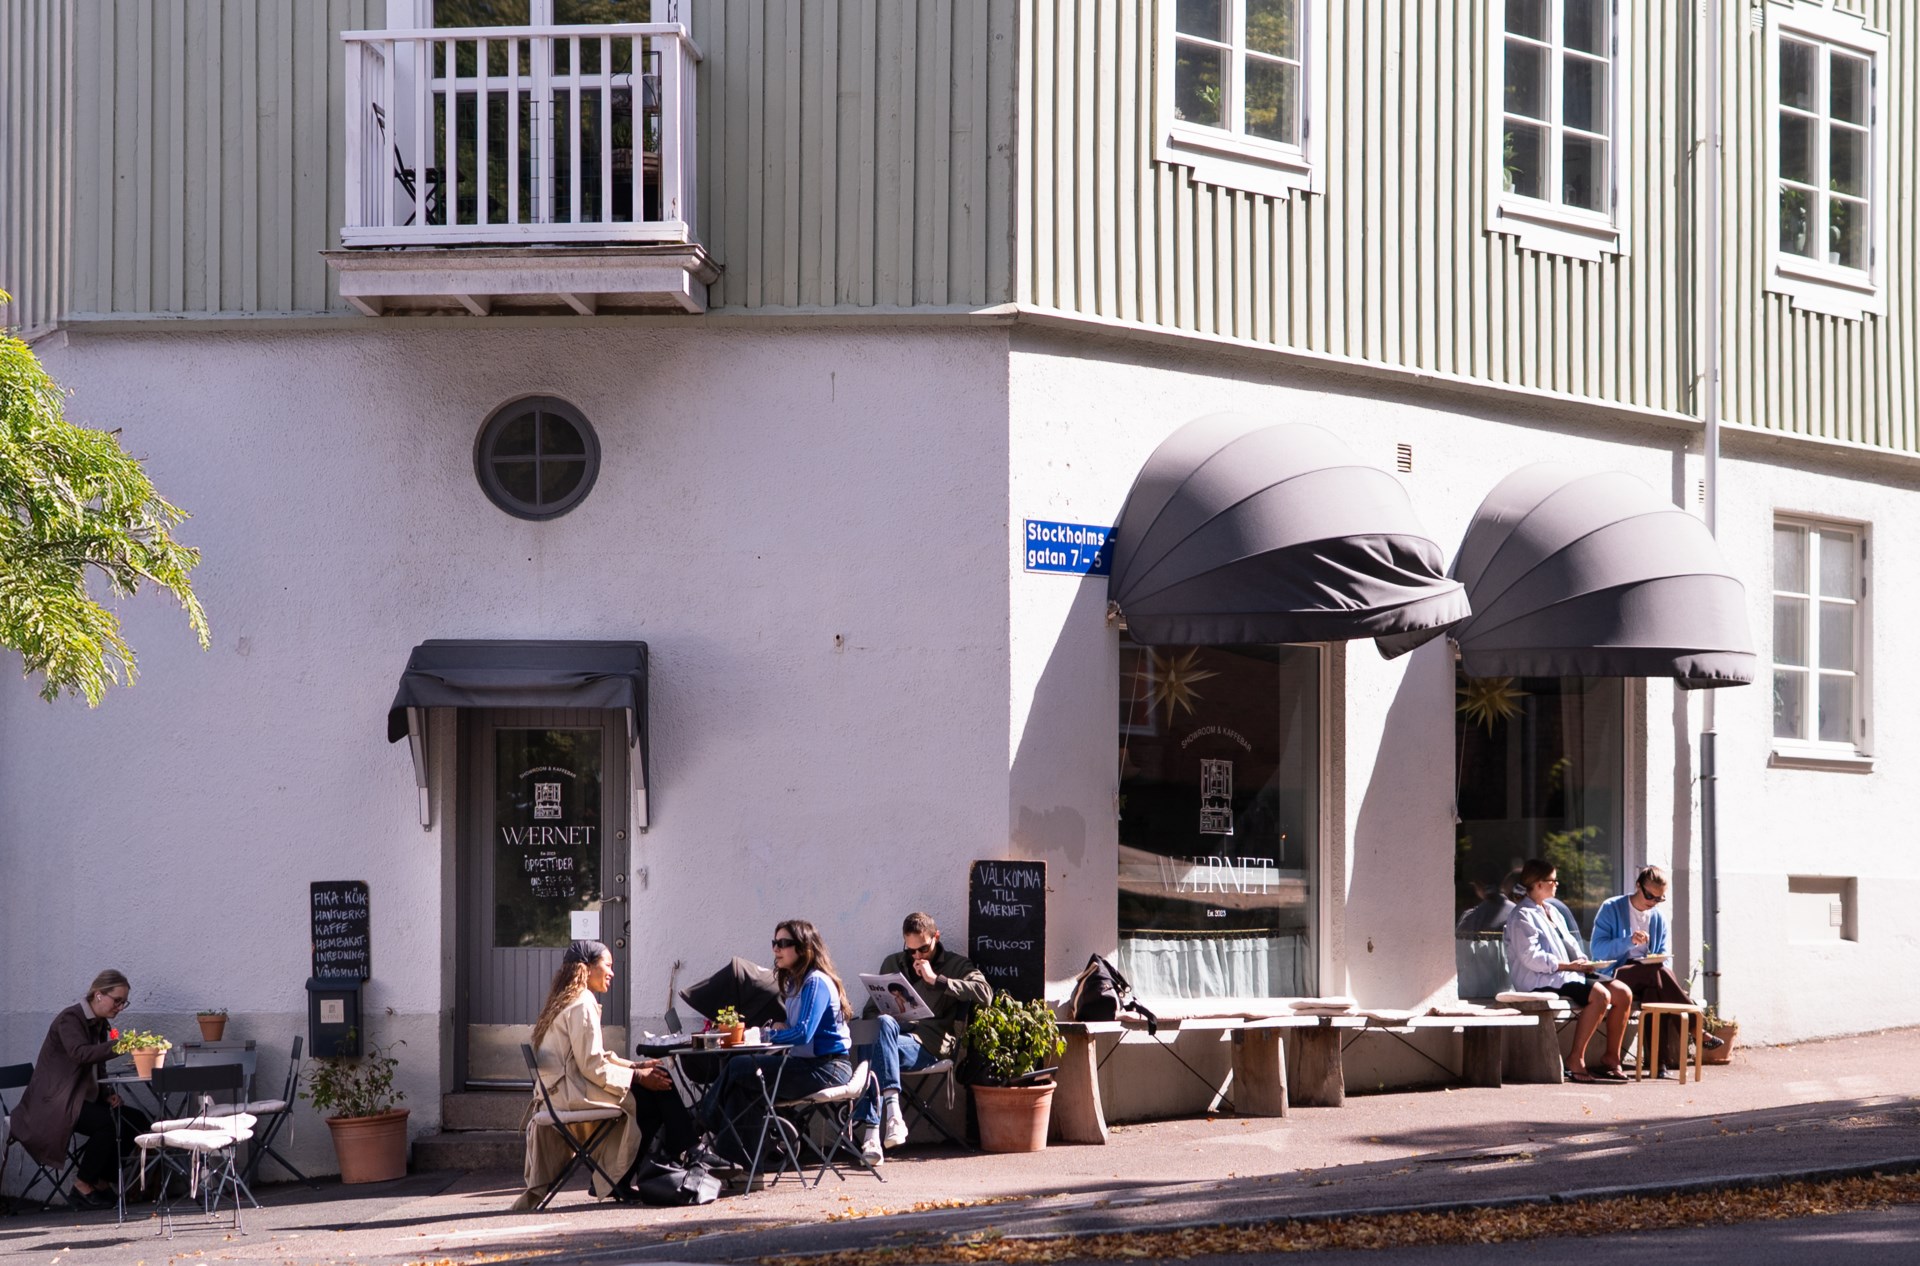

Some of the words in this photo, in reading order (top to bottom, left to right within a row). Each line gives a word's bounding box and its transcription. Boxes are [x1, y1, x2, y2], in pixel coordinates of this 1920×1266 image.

[1028, 547, 1066, 567] gatan
[1181, 725, 1216, 749] SHOWROOM
[1222, 727, 1252, 752] KAFFEBAR
[992, 889, 1018, 902] TILL
[315, 909, 367, 921] HANTVERKS
[978, 899, 1033, 918] WAERNET
[977, 935, 1035, 951] FRUKOST
